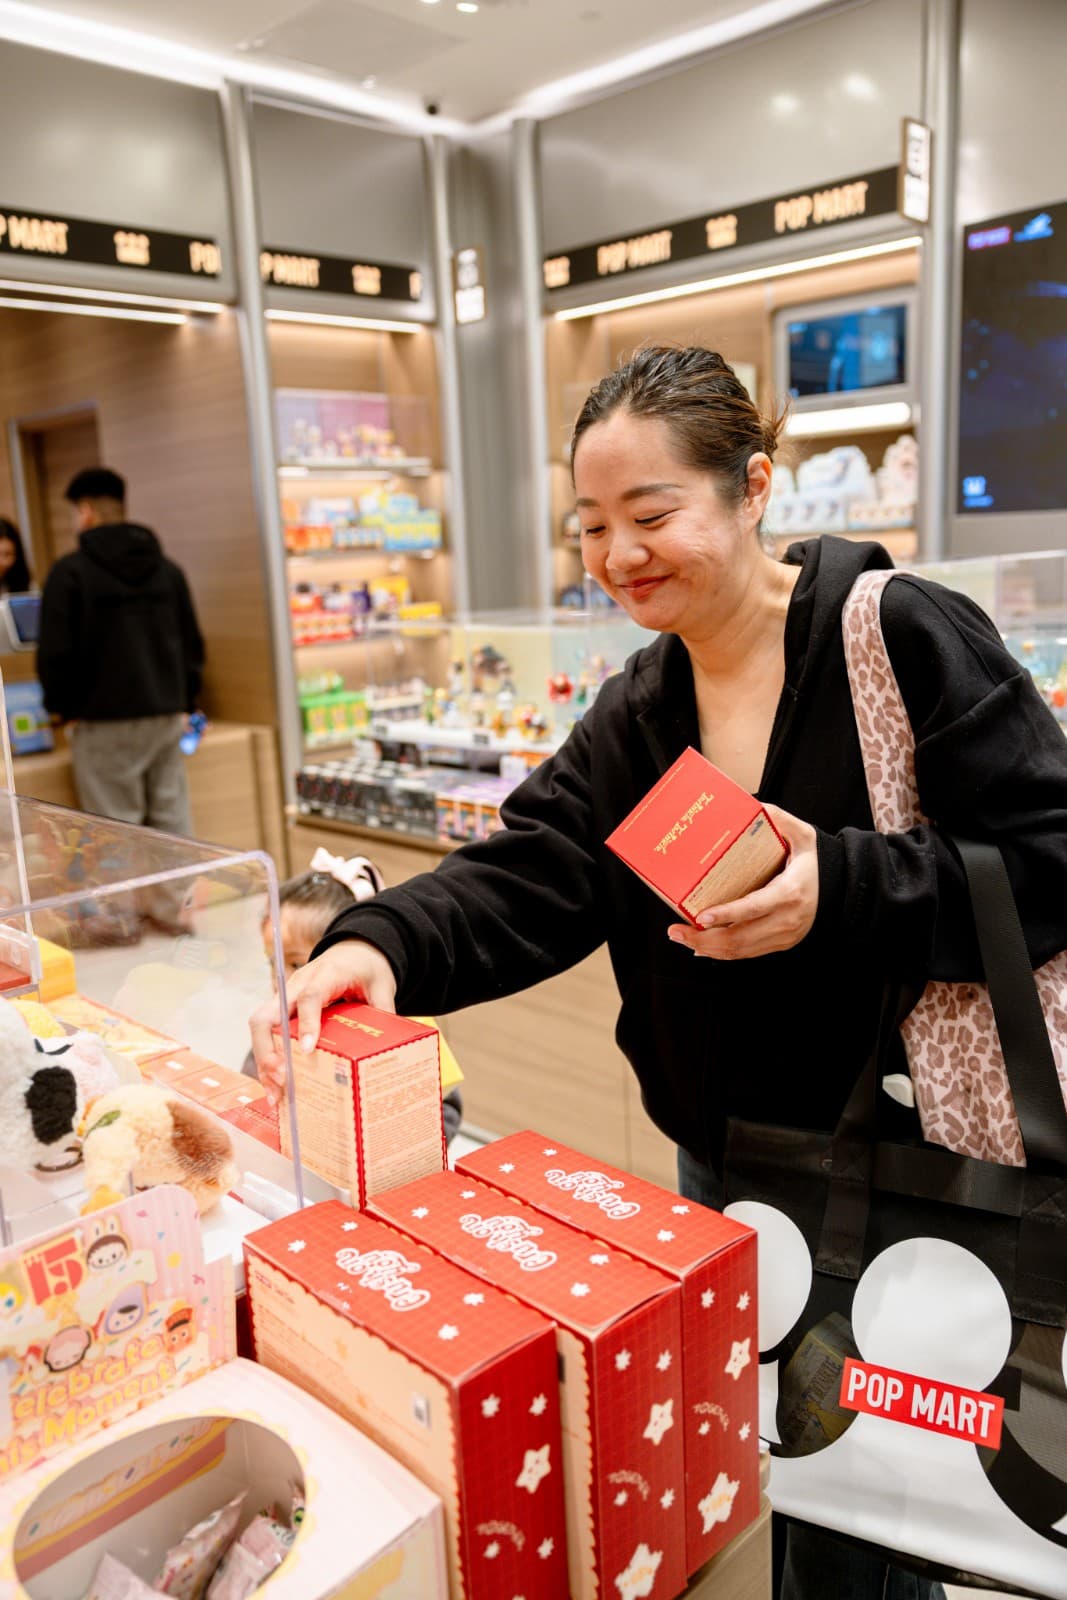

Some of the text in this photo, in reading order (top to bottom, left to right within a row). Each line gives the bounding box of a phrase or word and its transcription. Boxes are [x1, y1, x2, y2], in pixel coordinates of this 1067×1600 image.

[8, 214, 68, 254] MART
[775, 195, 813, 233] POP
[813, 181, 868, 224] MART
[44, 1358, 173, 1448] Moment
[847, 1367, 904, 1412] POP
[910, 1383, 996, 1439] MART
